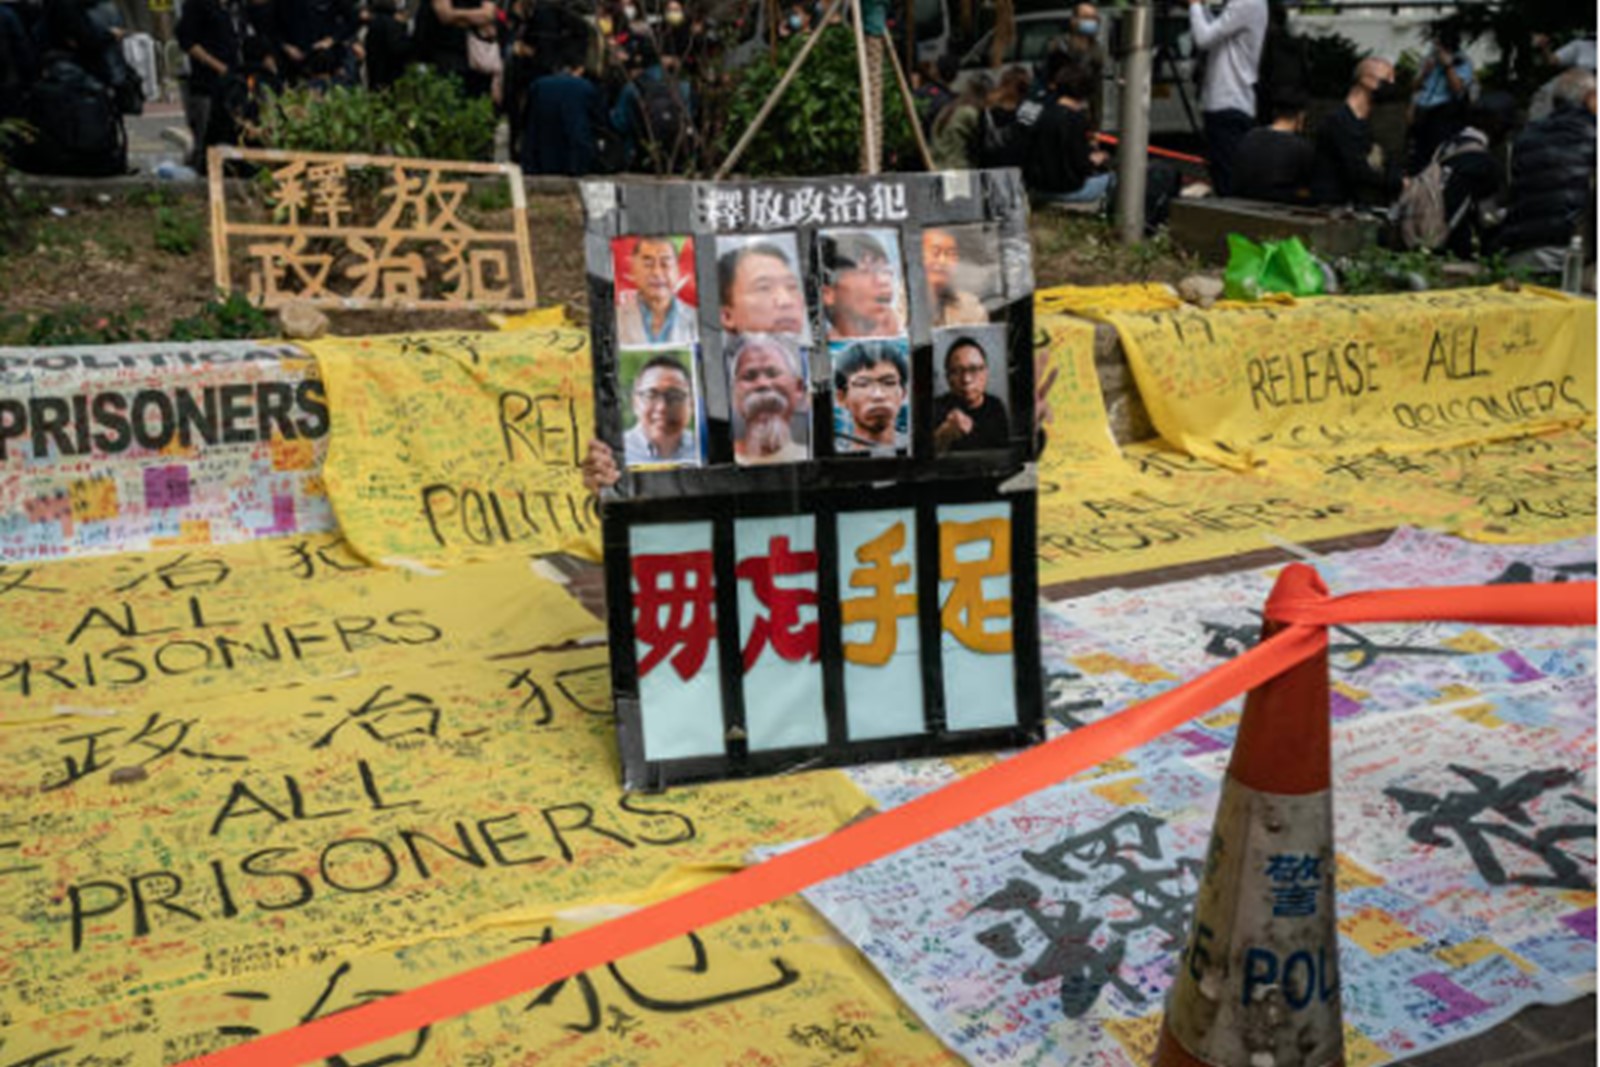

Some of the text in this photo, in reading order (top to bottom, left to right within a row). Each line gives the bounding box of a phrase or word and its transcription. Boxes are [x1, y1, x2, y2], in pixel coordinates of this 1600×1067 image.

[271, 157, 476, 231] 釋放
[705, 182, 908, 230] 釋放政治犯
[248, 234, 510, 301] 政治犯
[1247, 341, 1381, 409] RELEASE
[1422, 326, 1493, 383] ALL
[0, 378, 330, 461] PRISONERS
[66, 596, 241, 645] ALL
[210, 759, 422, 836] ALL
[67, 793, 696, 953] PRISONERS
